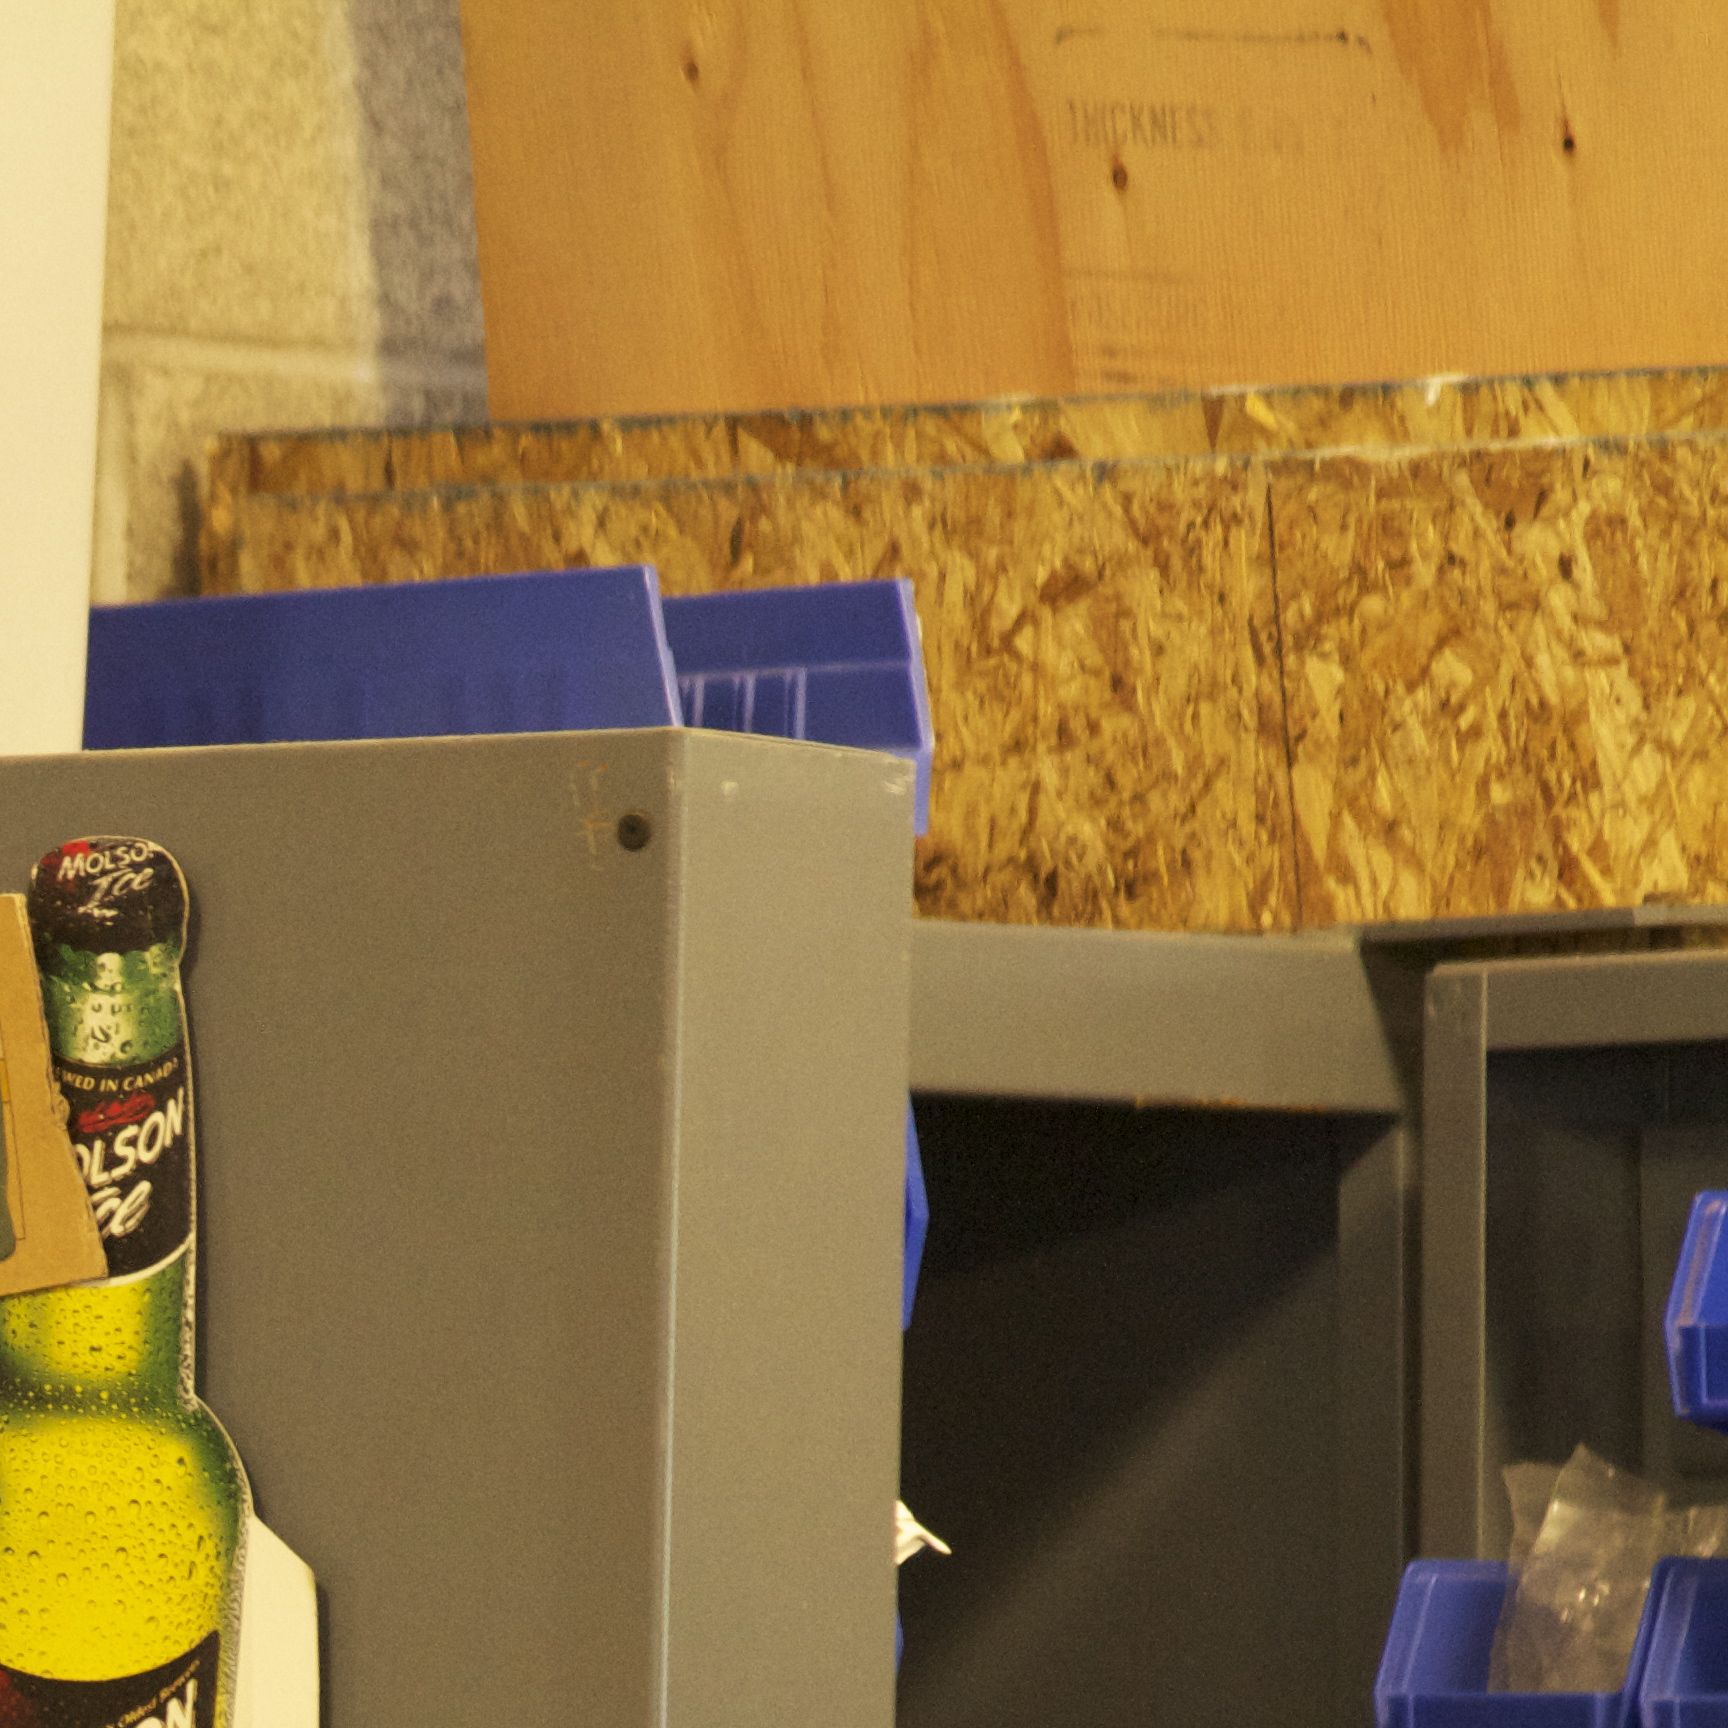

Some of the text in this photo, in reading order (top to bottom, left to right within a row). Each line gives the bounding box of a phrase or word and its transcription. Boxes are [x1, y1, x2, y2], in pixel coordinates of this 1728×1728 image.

[56, 842, 154, 882] MOLSO
[99, 1078, 118, 1092] IN
[73, 1087, 186, 1189] OLSON
[90, 1180, 152, 1241] ce
